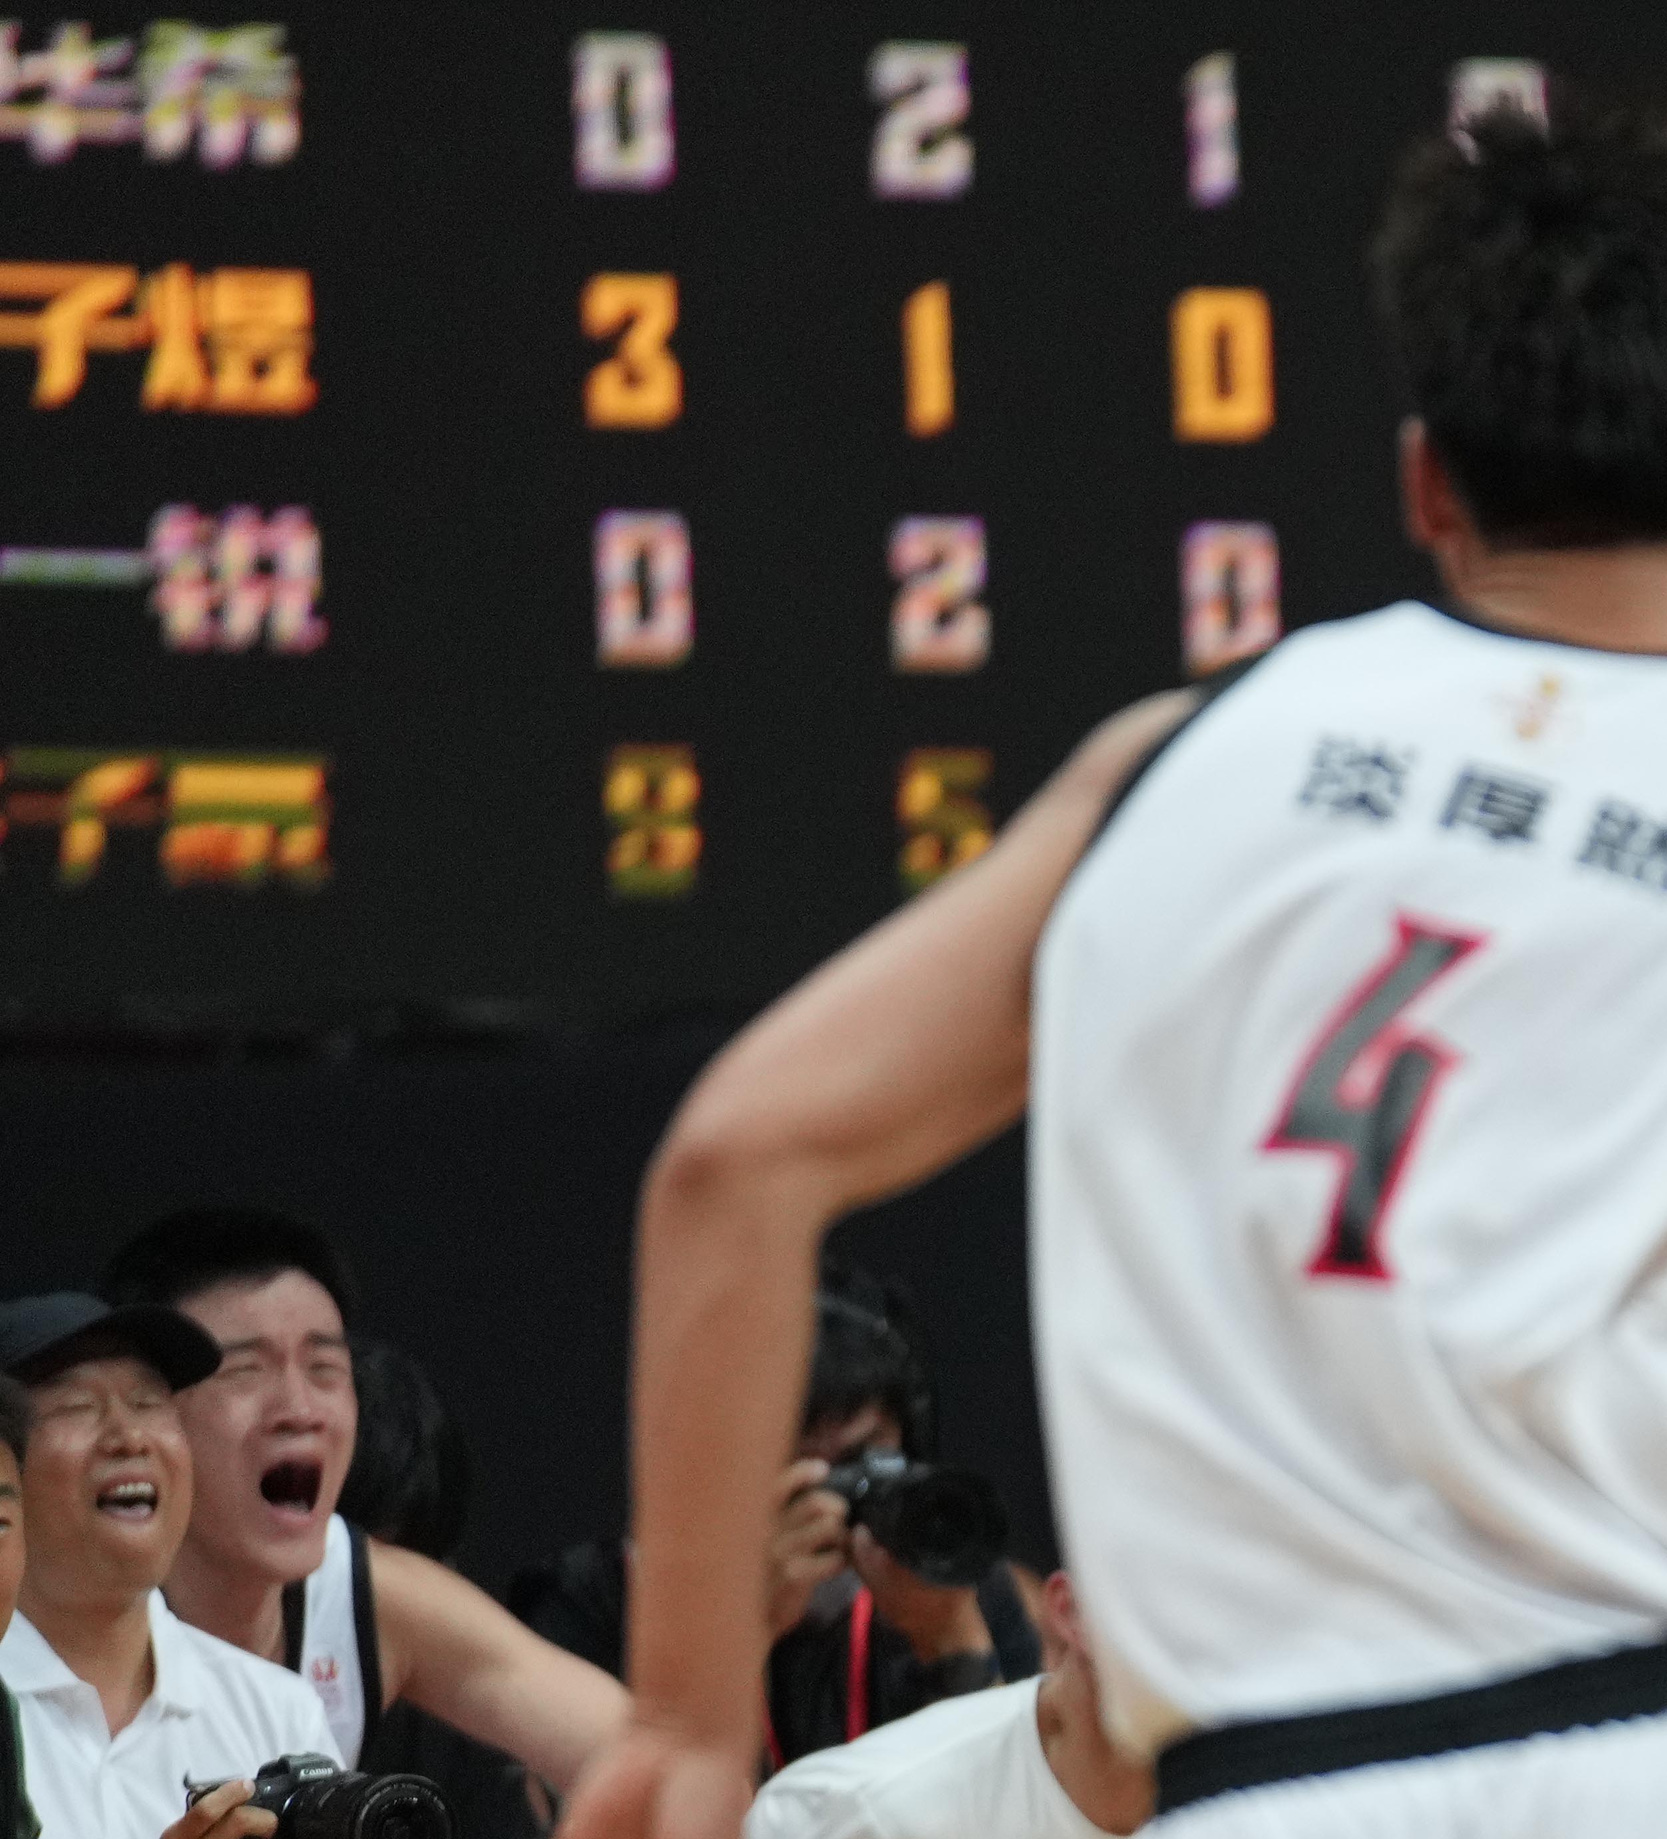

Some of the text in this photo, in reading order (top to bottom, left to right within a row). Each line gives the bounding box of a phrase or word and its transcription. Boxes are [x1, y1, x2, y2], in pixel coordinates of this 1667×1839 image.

[573, 33, 674, 188] 0
[873, 41, 972, 197] 2
[1187, 54, 1239, 204] 1
[581, 273, 683, 429] 3
[903, 282, 955, 436] 1
[1171, 287, 1275, 442] 0
[595, 510, 694, 666] 0
[889, 516, 990, 670] 2
[1260, 908, 1491, 1283] 4
[300, 1766, 334, 1778] Canon
